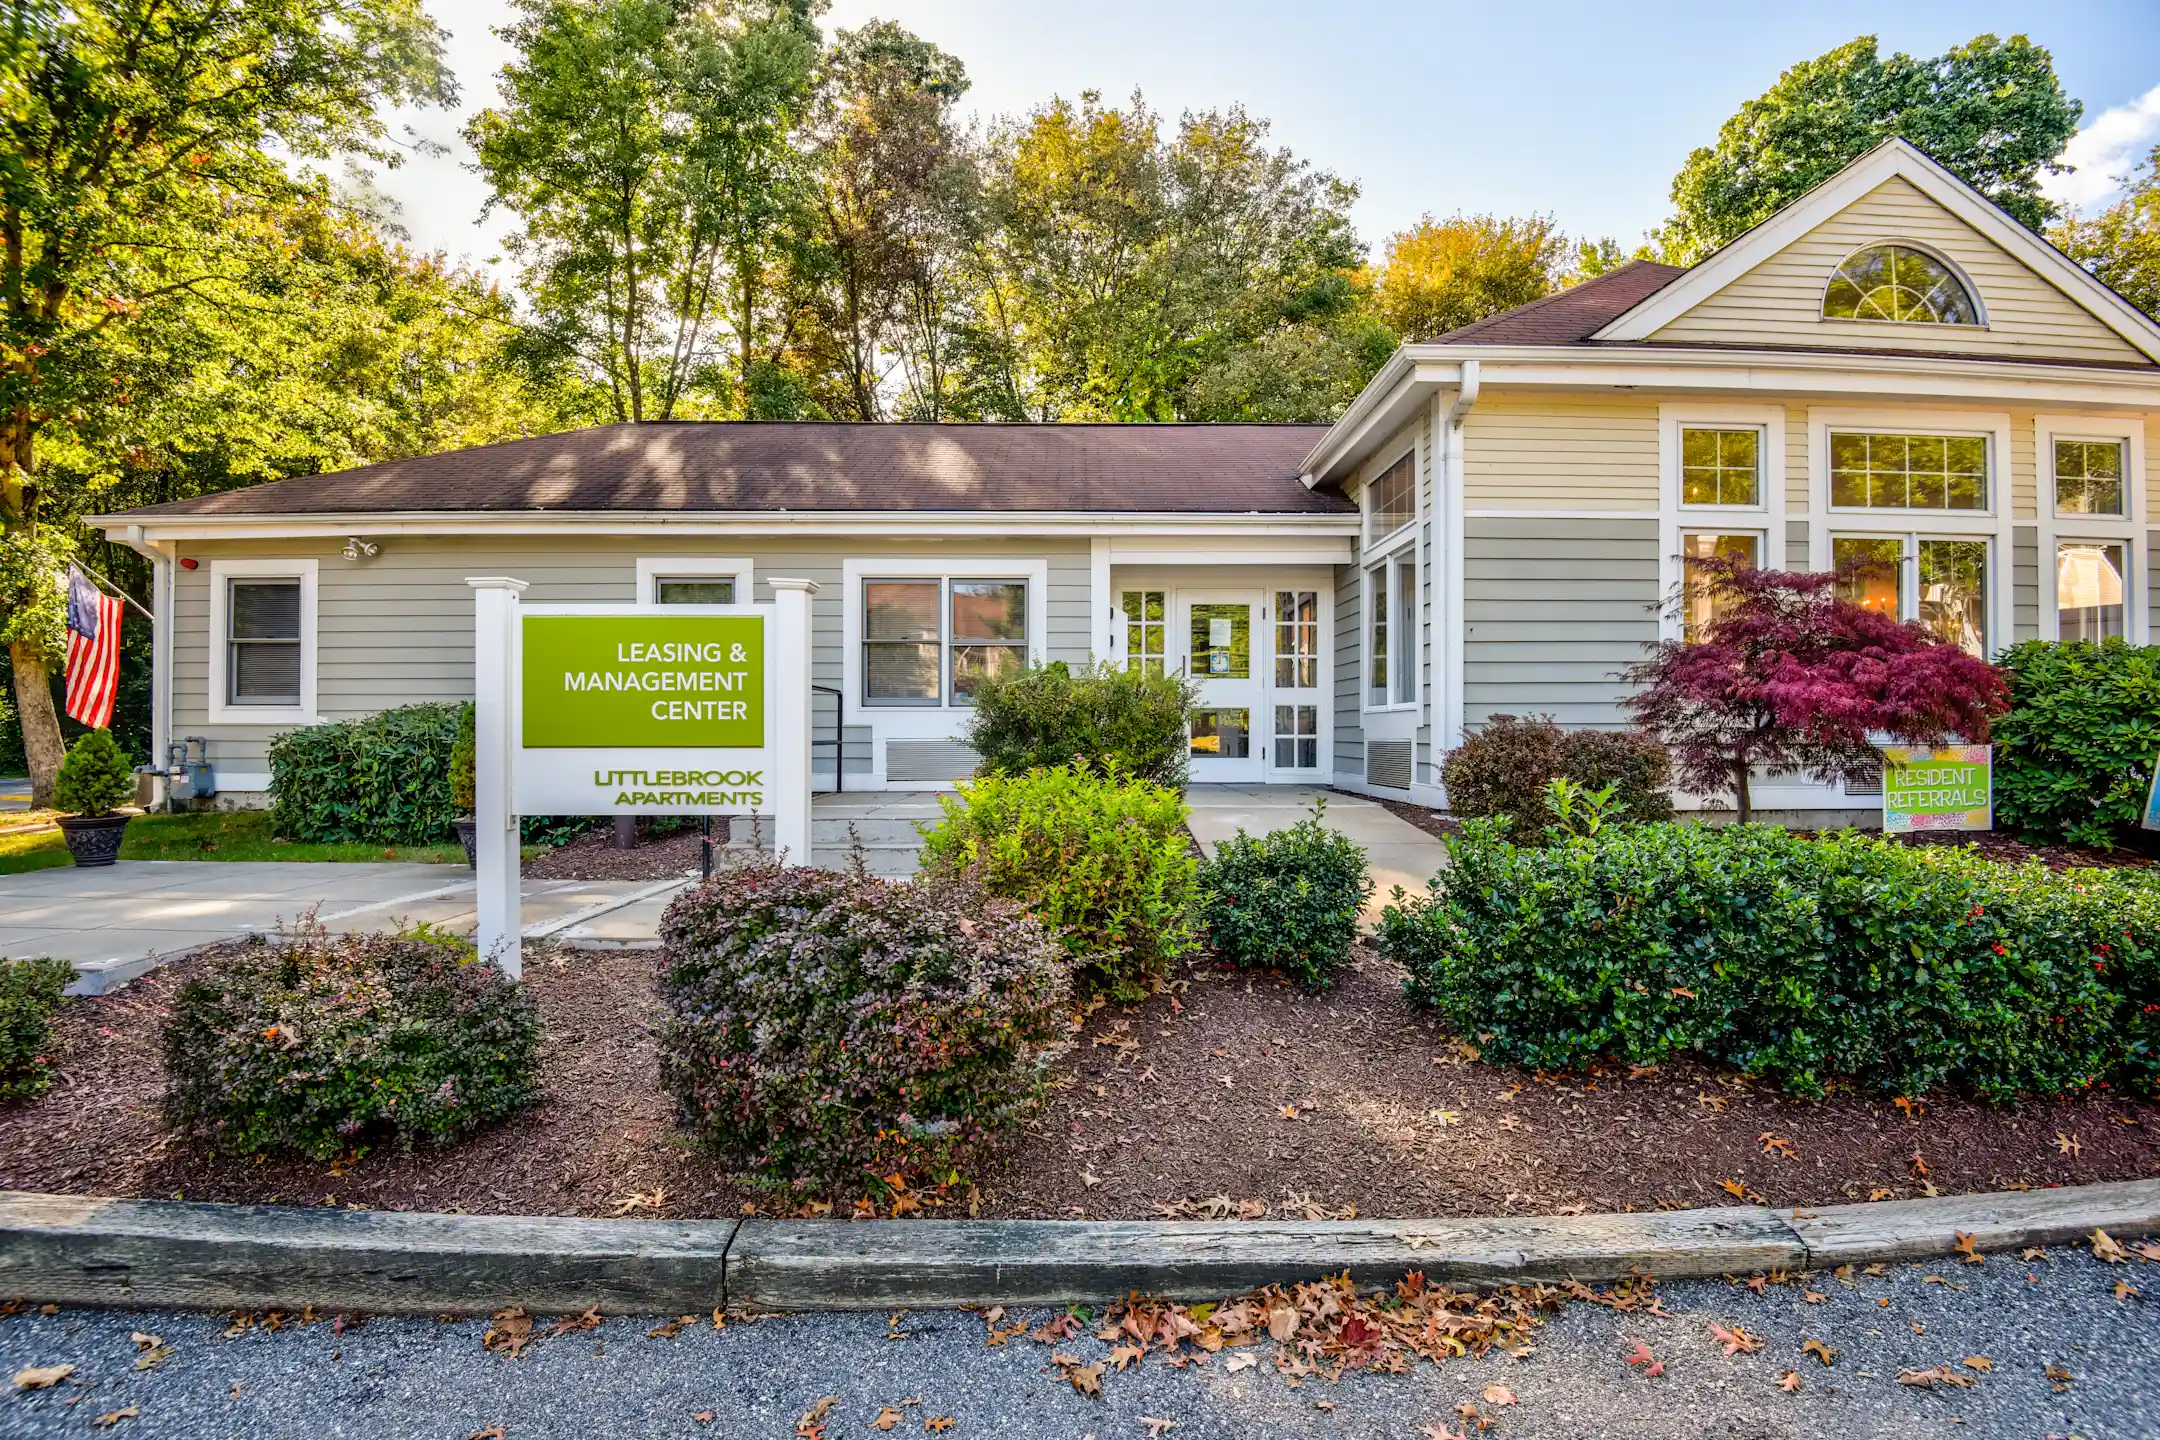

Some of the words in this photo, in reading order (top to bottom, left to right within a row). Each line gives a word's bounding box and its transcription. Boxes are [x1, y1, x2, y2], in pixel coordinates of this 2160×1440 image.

[617, 642, 722, 663] LEASING
[729, 642, 748, 663] &
[564, 671, 748, 692] MANAGEMENT
[651, 700, 748, 721] CENTER
[594, 770, 764, 787] LITTLEBROOK
[1896, 768, 1976, 788] RESIDENT
[614, 791, 763, 806] APARTMENTS
[1887, 789, 1987, 809] REFERRALS
